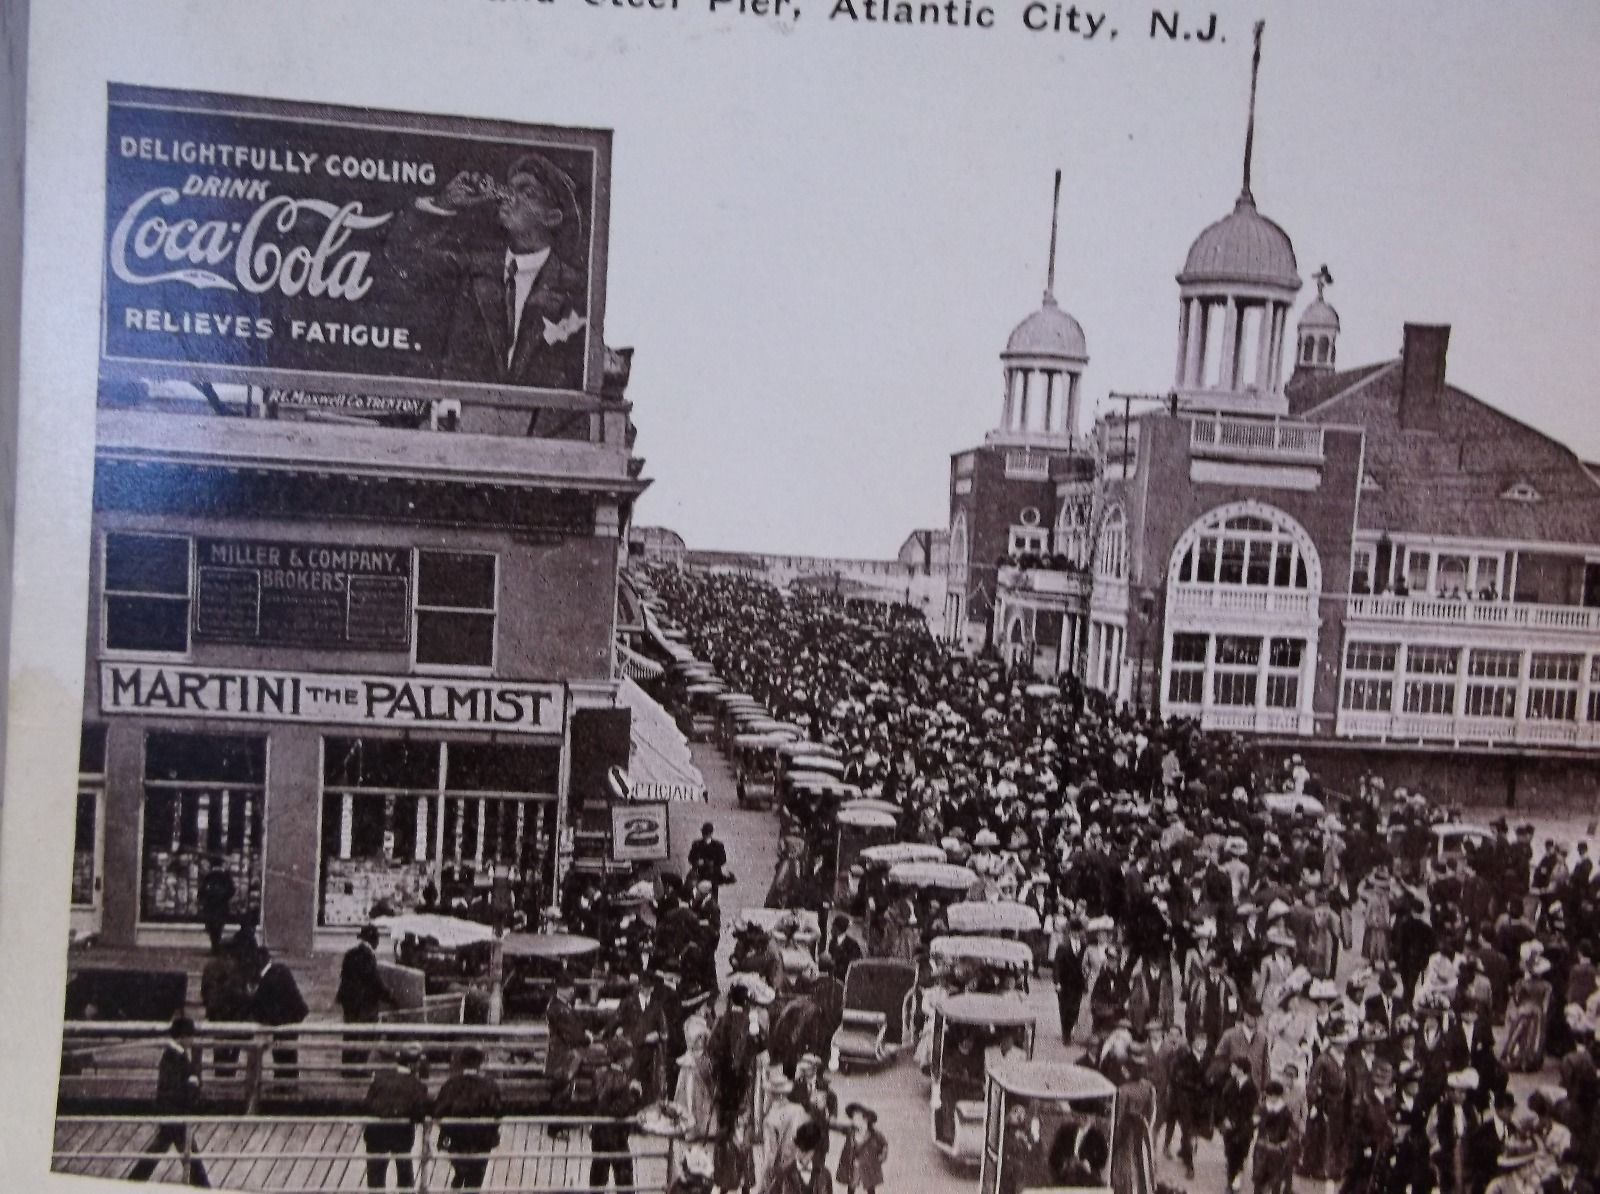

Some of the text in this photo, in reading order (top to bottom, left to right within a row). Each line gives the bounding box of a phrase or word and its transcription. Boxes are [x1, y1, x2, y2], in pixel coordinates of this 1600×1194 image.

[829, 0, 996, 28] Atlantic
[1023, 2, 1118, 39] City,
[1149, 10, 1227, 43] N.J.
[119, 135, 437, 185] DELIGHTFULLY COOLING
[182, 175, 270, 201] DRINK
[125, 309, 422, 351] RELIEVES FATIGUE.
[211, 544, 401, 573] MILLER & COMPANY.
[263, 568, 346, 592] BROKERS
[111, 667, 553, 727] MARTINI THE PALMIST
